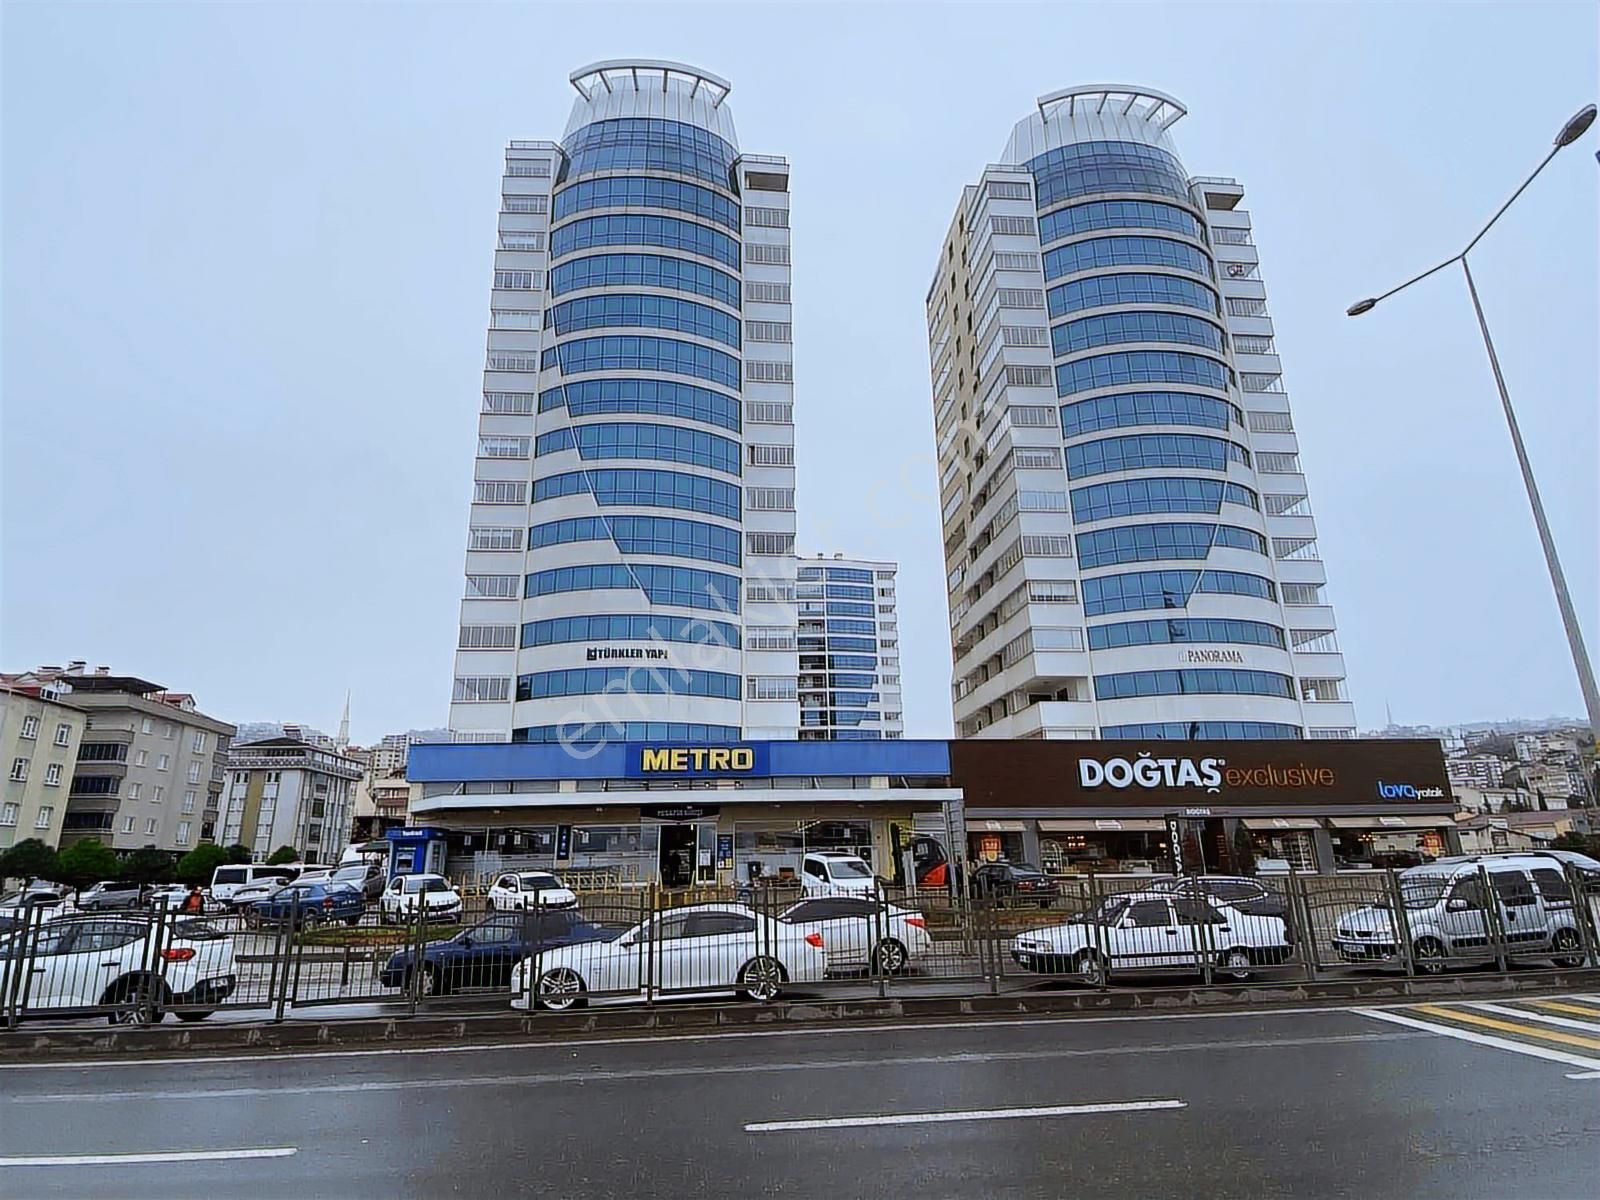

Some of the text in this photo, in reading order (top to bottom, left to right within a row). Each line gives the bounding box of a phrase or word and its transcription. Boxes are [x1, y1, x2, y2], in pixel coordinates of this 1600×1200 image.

[597, 647, 643, 659] TÜRKLER
[1187, 650, 1243, 663] PANORAMA
[642, 748, 753, 771] METRO
[1079, 752, 1335, 793] DOĞTAŞ exclusive
